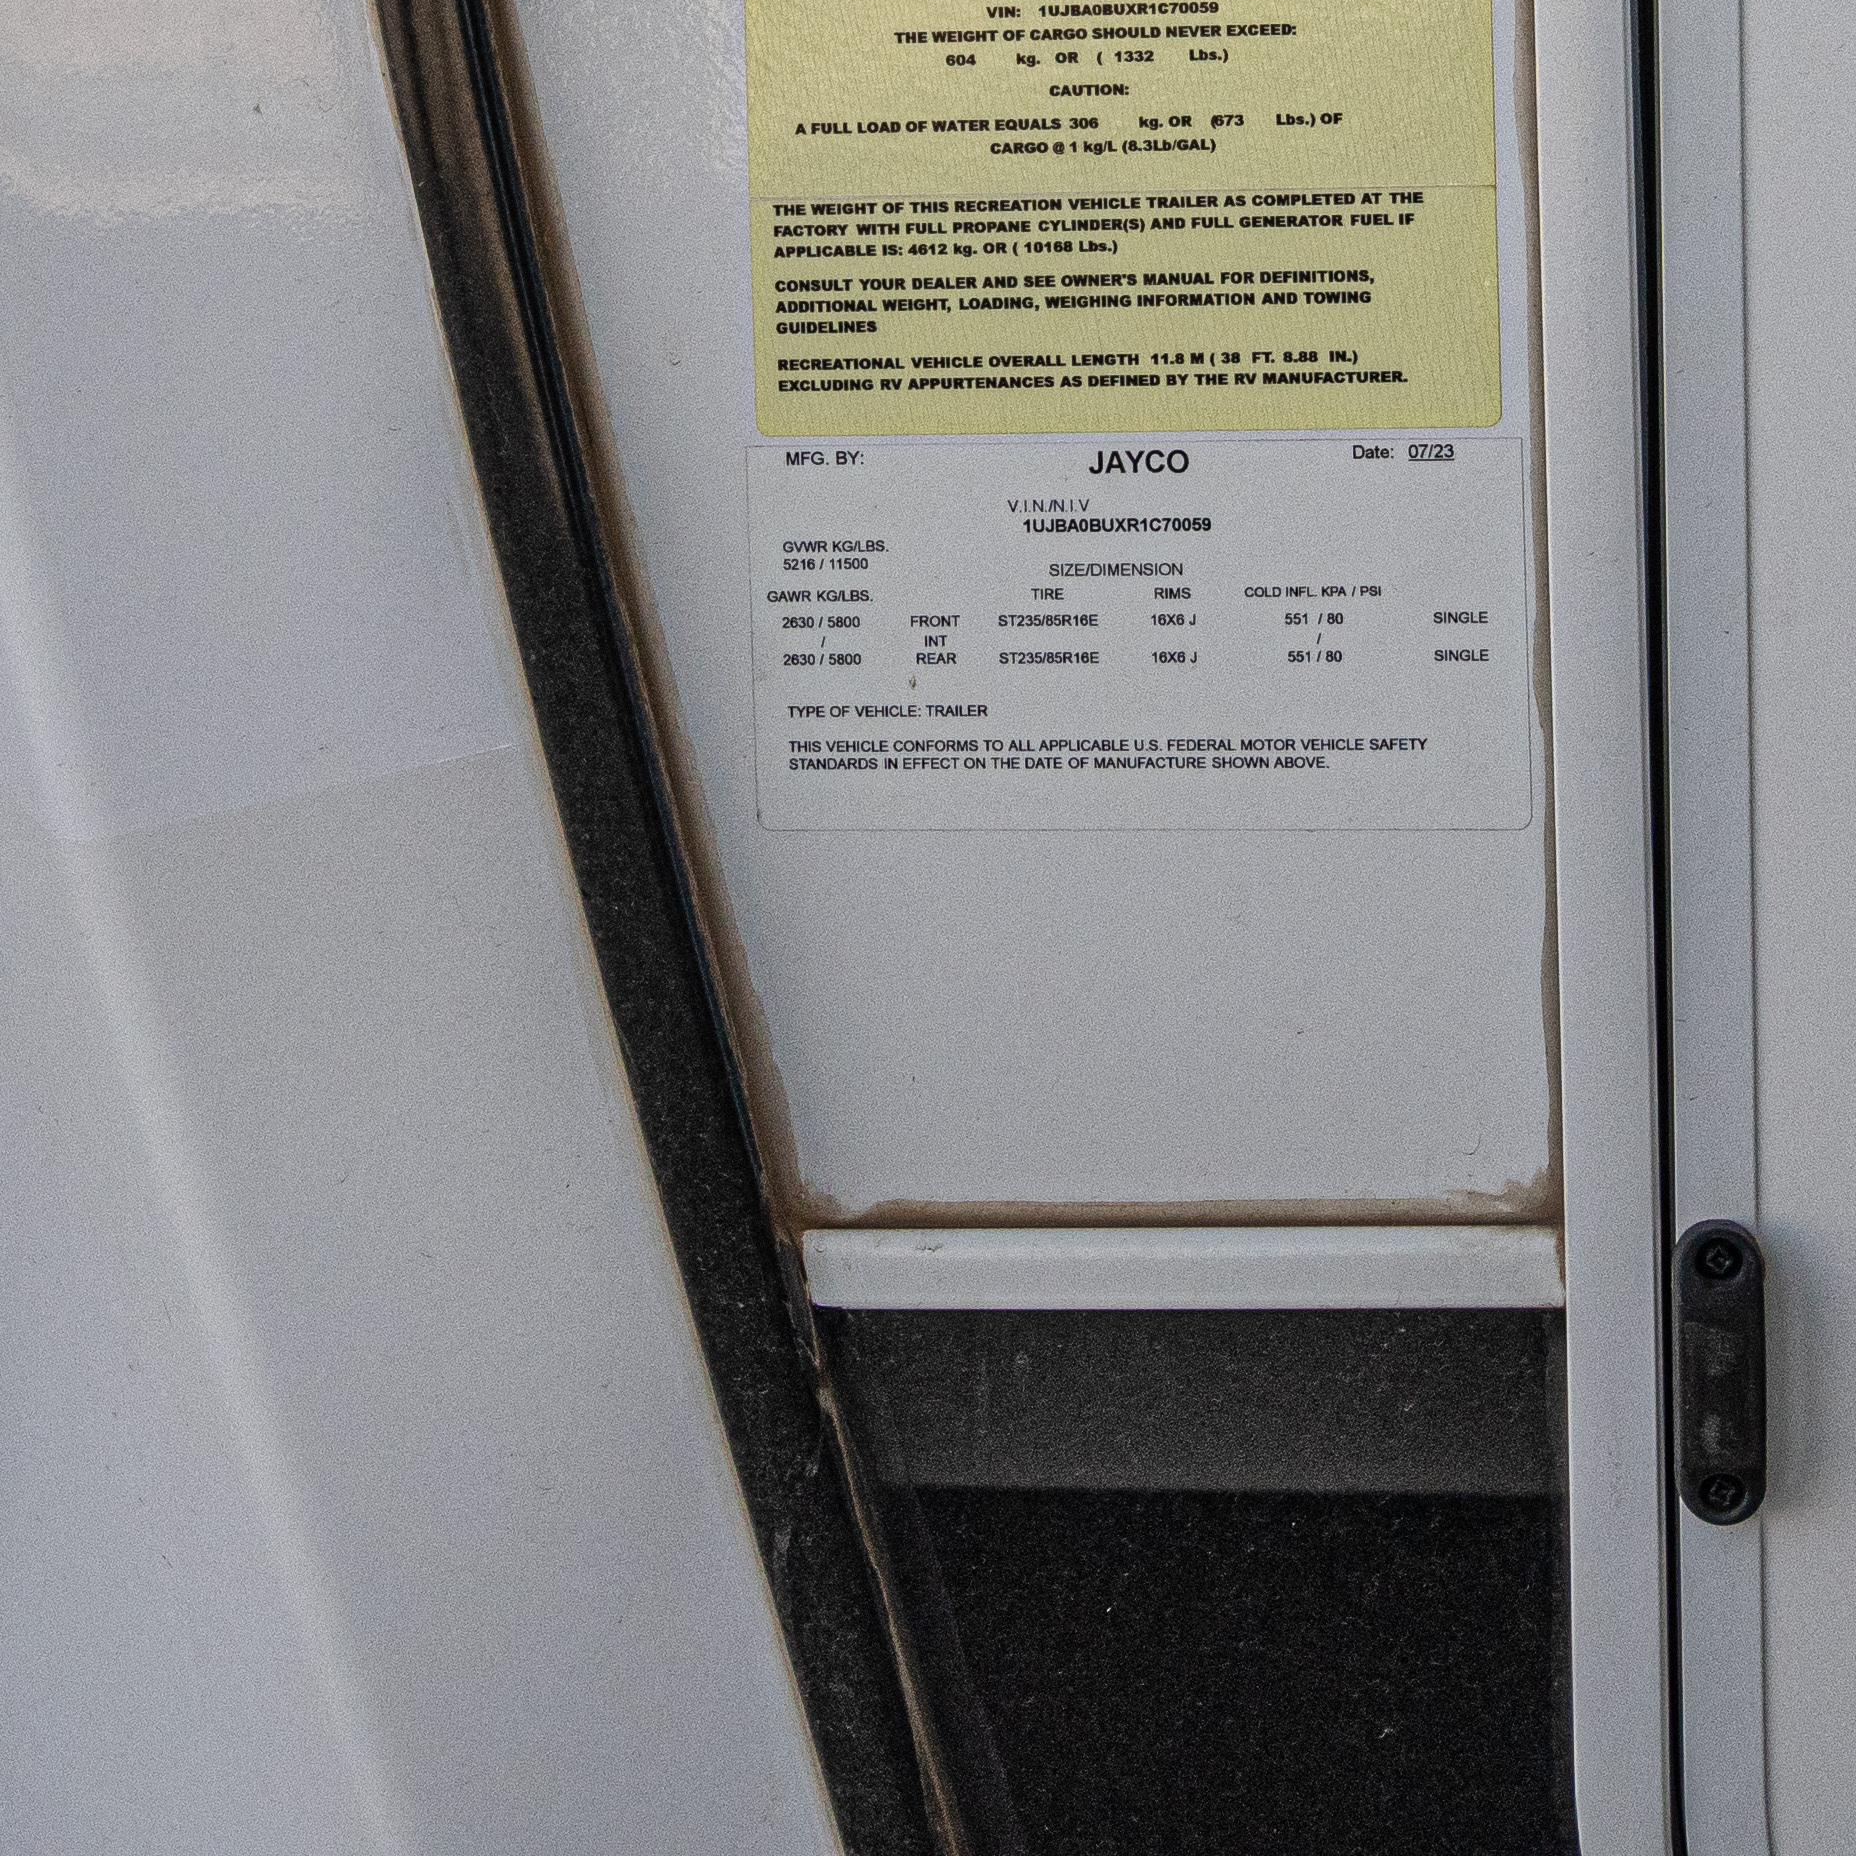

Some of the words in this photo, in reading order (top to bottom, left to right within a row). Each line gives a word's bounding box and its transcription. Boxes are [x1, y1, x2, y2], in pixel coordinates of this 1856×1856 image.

[986, 6, 1021, 19] VIN:
[1038, 1, 1220, 18] 1UJBA0BUXR1C70059
[893, 31, 928, 44] THE
[931, 29, 999, 44] WEIGHT
[1002, 29, 1025, 42] OF
[1029, 27, 1088, 41] CARGO
[1092, 26, 1162, 40] SHOULD
[1165, 24, 1222, 38] NEVER
[1226, 23, 1297, 37] EXCEED:
[1048, 83, 1130, 97] CAUTION:
[795, 122, 807, 135] A
[810, 121, 853, 135] FULL
[856, 121, 902, 134] LOAD
[905, 120, 928, 133] OF
[931, 119, 990, 133] WATER
[994, 117, 1062, 132] EQUALS
[1069, 116, 1100, 130] 306
[1138, 116, 1164, 131] kg.
[1167, 115, 1192, 128] OR
[1275, 113, 1317, 128] Lbs.)
[1319, 112, 1343, 125] OF
[989, 141, 1049, 155] CARGO
[1052, 141, 1065, 155] @
[1069, 141, 1078, 153] 1
[1083, 140, 1118, 156] kg/L
[1121, 138, 1217, 155] (8.3Lb/GAL)
[772, 203, 807, 217] THE
[810, 202, 878, 216] WEIGHT
[882, 201, 904, 215] OF
[909, 201, 950, 214] THIS
[954, 198, 1063, 213] RECREATION
[1067, 196, 1141, 211] VEHICLE
[1145, 195, 1219, 209] TRAILER
[1223, 194, 1247, 208] AS
[1251, 192, 1356, 207] COMPLETED
[1360, 192, 1383, 205] AT
[1389, 191, 1424, 205] THE
[773, 224, 848, 238] FACTORY
[856, 223, 900, 236] WITH
[905, 222, 947, 235] FULL
[952, 220, 1031, 234] PROPANE
[1038, 218, 1146, 233] CYLINDER(S)
[1150, 217, 1186, 230] AND
[1190, 216, 1235, 230] FULL
[1238, 214, 1344, 229] GENERATOR
[1350, 213, 1395, 227] FUEL
[1398, 212, 1415, 226] IF
[775, 299, 878, 314] ADDITIONAL
[881, 298, 952, 313] WEIGHT,
[958, 296, 1040, 312] LOADING,
[1044, 294, 1132, 309] WEIGHING
[1136, 292, 1256, 307] INFORMATION
[1261, 291, 1298, 305] AND
[1303, 290, 1372, 305] TOWING
[775, 320, 878, 335] GUIDELINES
[785, 450, 830, 466] MFG.
[835, 450, 864, 466] BY:
[1352, 444, 1394, 460] Date:
[1407, 443, 1455, 462] 07/23
[1088, 449, 1190, 475] JAYCO
[1023, 517, 1212, 534] 1UJBA0BUXR1C70059
[782, 540, 828, 554] GVWR
[831, 539, 890, 553] KG/LBS.
[783, 557, 816, 571] 5216
[819, 558, 825, 570] /
[829, 557, 869, 570] 11500
[1048, 562, 1184, 578] SIZE/DIMENSION
[766, 589, 812, 603] GAWR
[816, 589, 874, 603] KG/LBS.
[1030, 587, 1064, 601] TIRE
[1153, 586, 1192, 600] RIMS
[782, 615, 815, 630] 2630
[817, 616, 824, 628] /
[827, 615, 861, 629] 5800
[910, 614, 961, 628] FRONT
[997, 613, 1099, 628] ST235/85R16E
[1150, 613, 1186, 627] 16X6
[1188, 613, 1197, 626] J
[1432, 610, 1489, 625] SINGLE
[923, 634, 948, 648] INT
[915, 652, 957, 665] REAR
[998, 651, 1100, 665] ST235/85R16E
[1151, 650, 1187, 664] 16X6
[1189, 651, 1198, 664] J
[1433, 648, 1490, 663] SINGLE
[787, 705, 826, 719] TYPE
[829, 705, 850, 718] OF
[854, 704, 922, 718] VEHICLE:
[925, 704, 989, 718] TRAILER
[788, 740, 822, 753] THIS
[825, 739, 889, 753] VEHICLE
[892, 739, 979, 753] CONFORMS
[983, 739, 1004, 752] TO
[1008, 738, 1035, 753] ALL
[1038, 738, 1130, 753] APPLICABLE
[1133, 739, 1163, 752] U.S.
[1166, 738, 1236, 752] FEDERAL
[1240, 738, 1296, 752] MOTOR
[1300, 738, 1364, 752] VEHICLE
[1369, 737, 1428, 752] SAFETY
[789, 757, 879, 771] STANDARDS
[883, 757, 899, 770] IN
[902, 756, 960, 771] EFFECT
[963, 756, 987, 770] ON
[991, 756, 1020, 770] THE
[1024, 756, 1063, 770] DATE
[1067, 756, 1089, 770] OF
[1093, 756, 1206, 770] MANUFACTURE
[1211, 756, 1270, 769] SHOWN
[1273, 755, 1330, 769] ABOVE.
